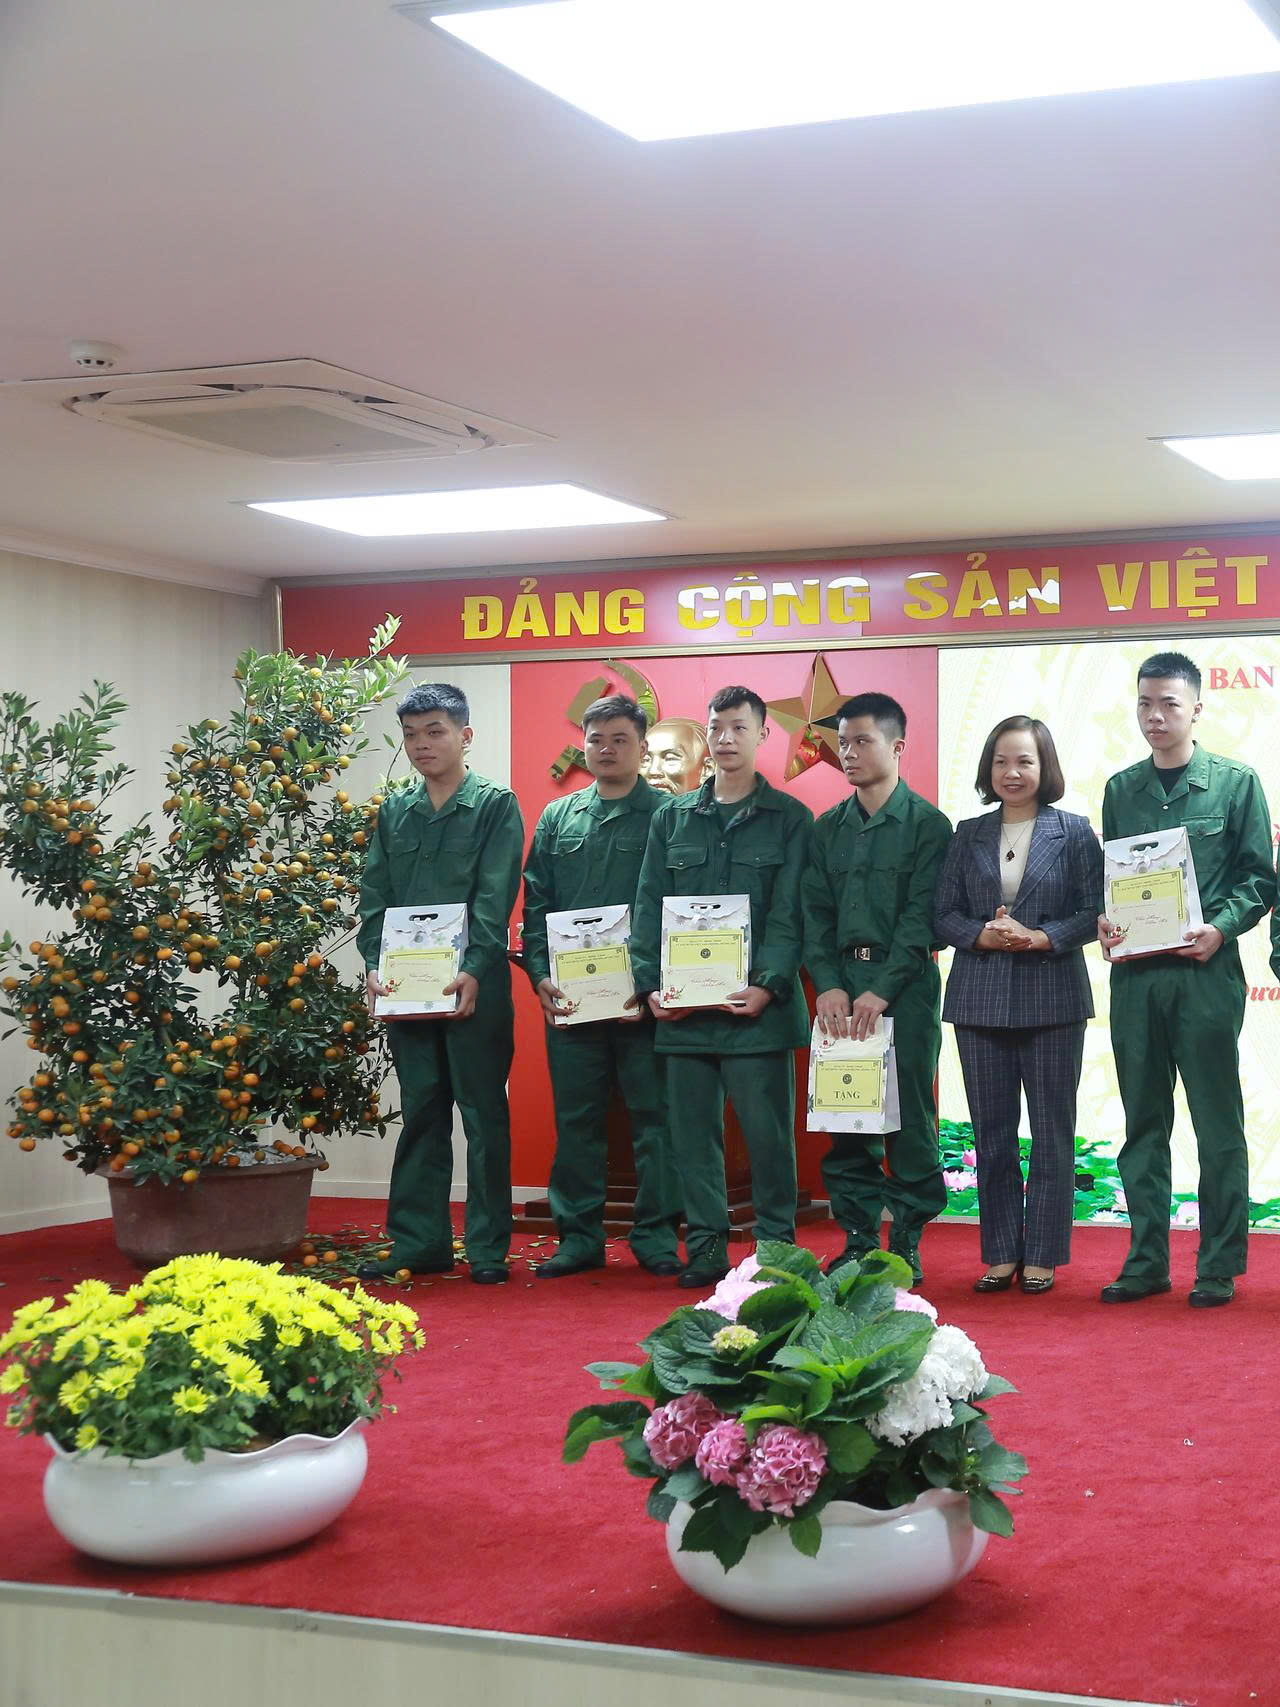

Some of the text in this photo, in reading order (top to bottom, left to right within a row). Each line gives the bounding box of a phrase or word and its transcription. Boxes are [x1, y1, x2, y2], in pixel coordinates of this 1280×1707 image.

[462, 577, 646, 641] ĐẢNG
[677, 571, 871, 640] CỘNG
[904, 550, 1061, 621] SẢN
[1097, 547, 1269, 618] VIỆT
[1210, 665, 1274, 691] BAN
